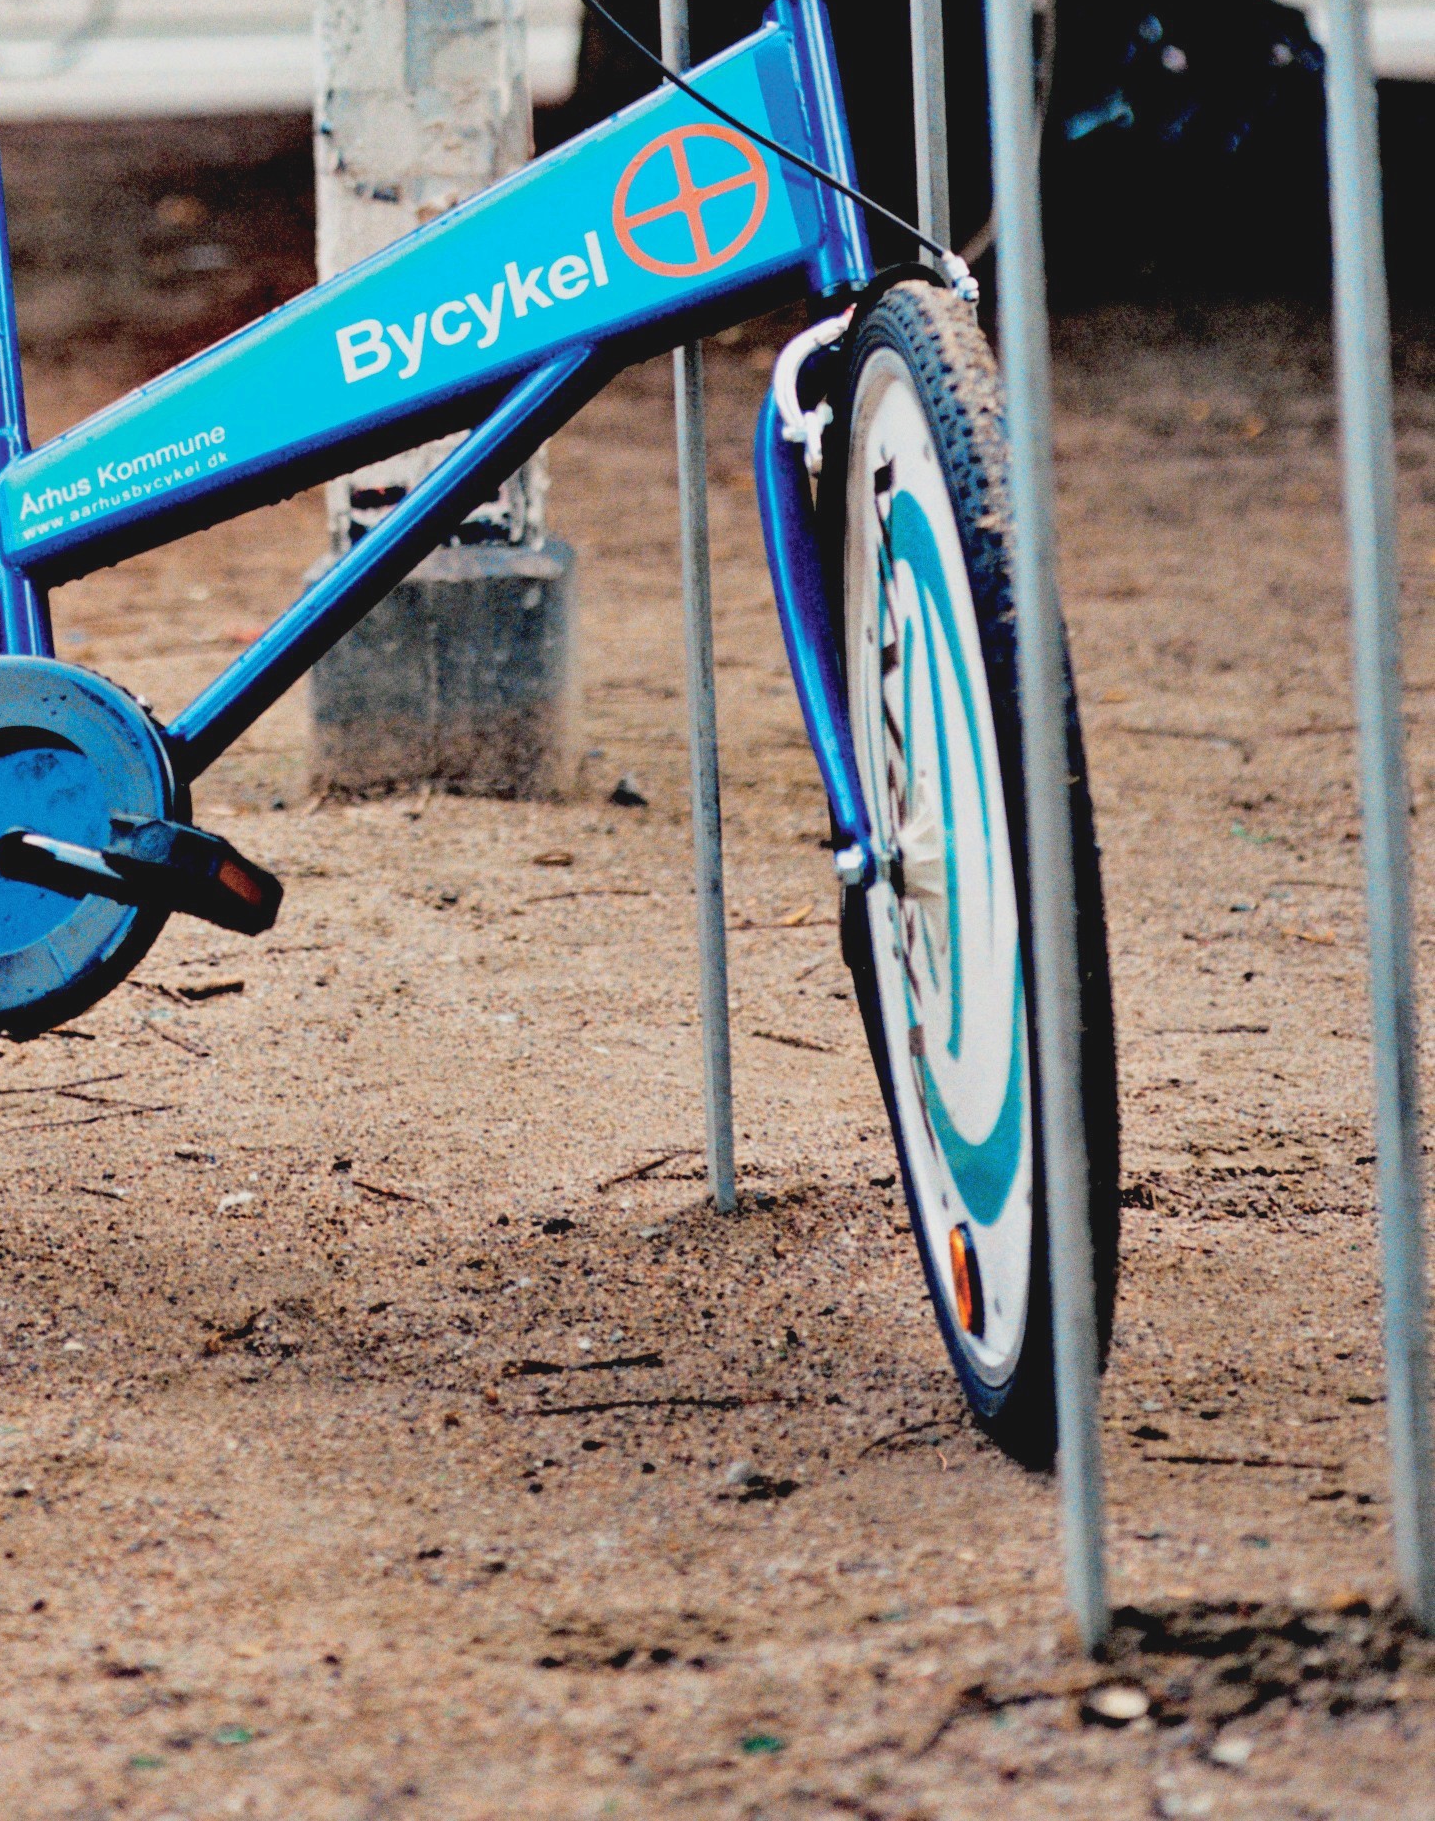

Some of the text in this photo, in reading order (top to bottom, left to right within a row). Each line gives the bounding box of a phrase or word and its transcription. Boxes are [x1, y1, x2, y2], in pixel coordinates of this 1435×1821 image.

[335, 230, 609, 383] Bycykel
[22, 450, 228, 541] www.aarhusbycykeldk
[96, 425, 226, 488] Kommune
